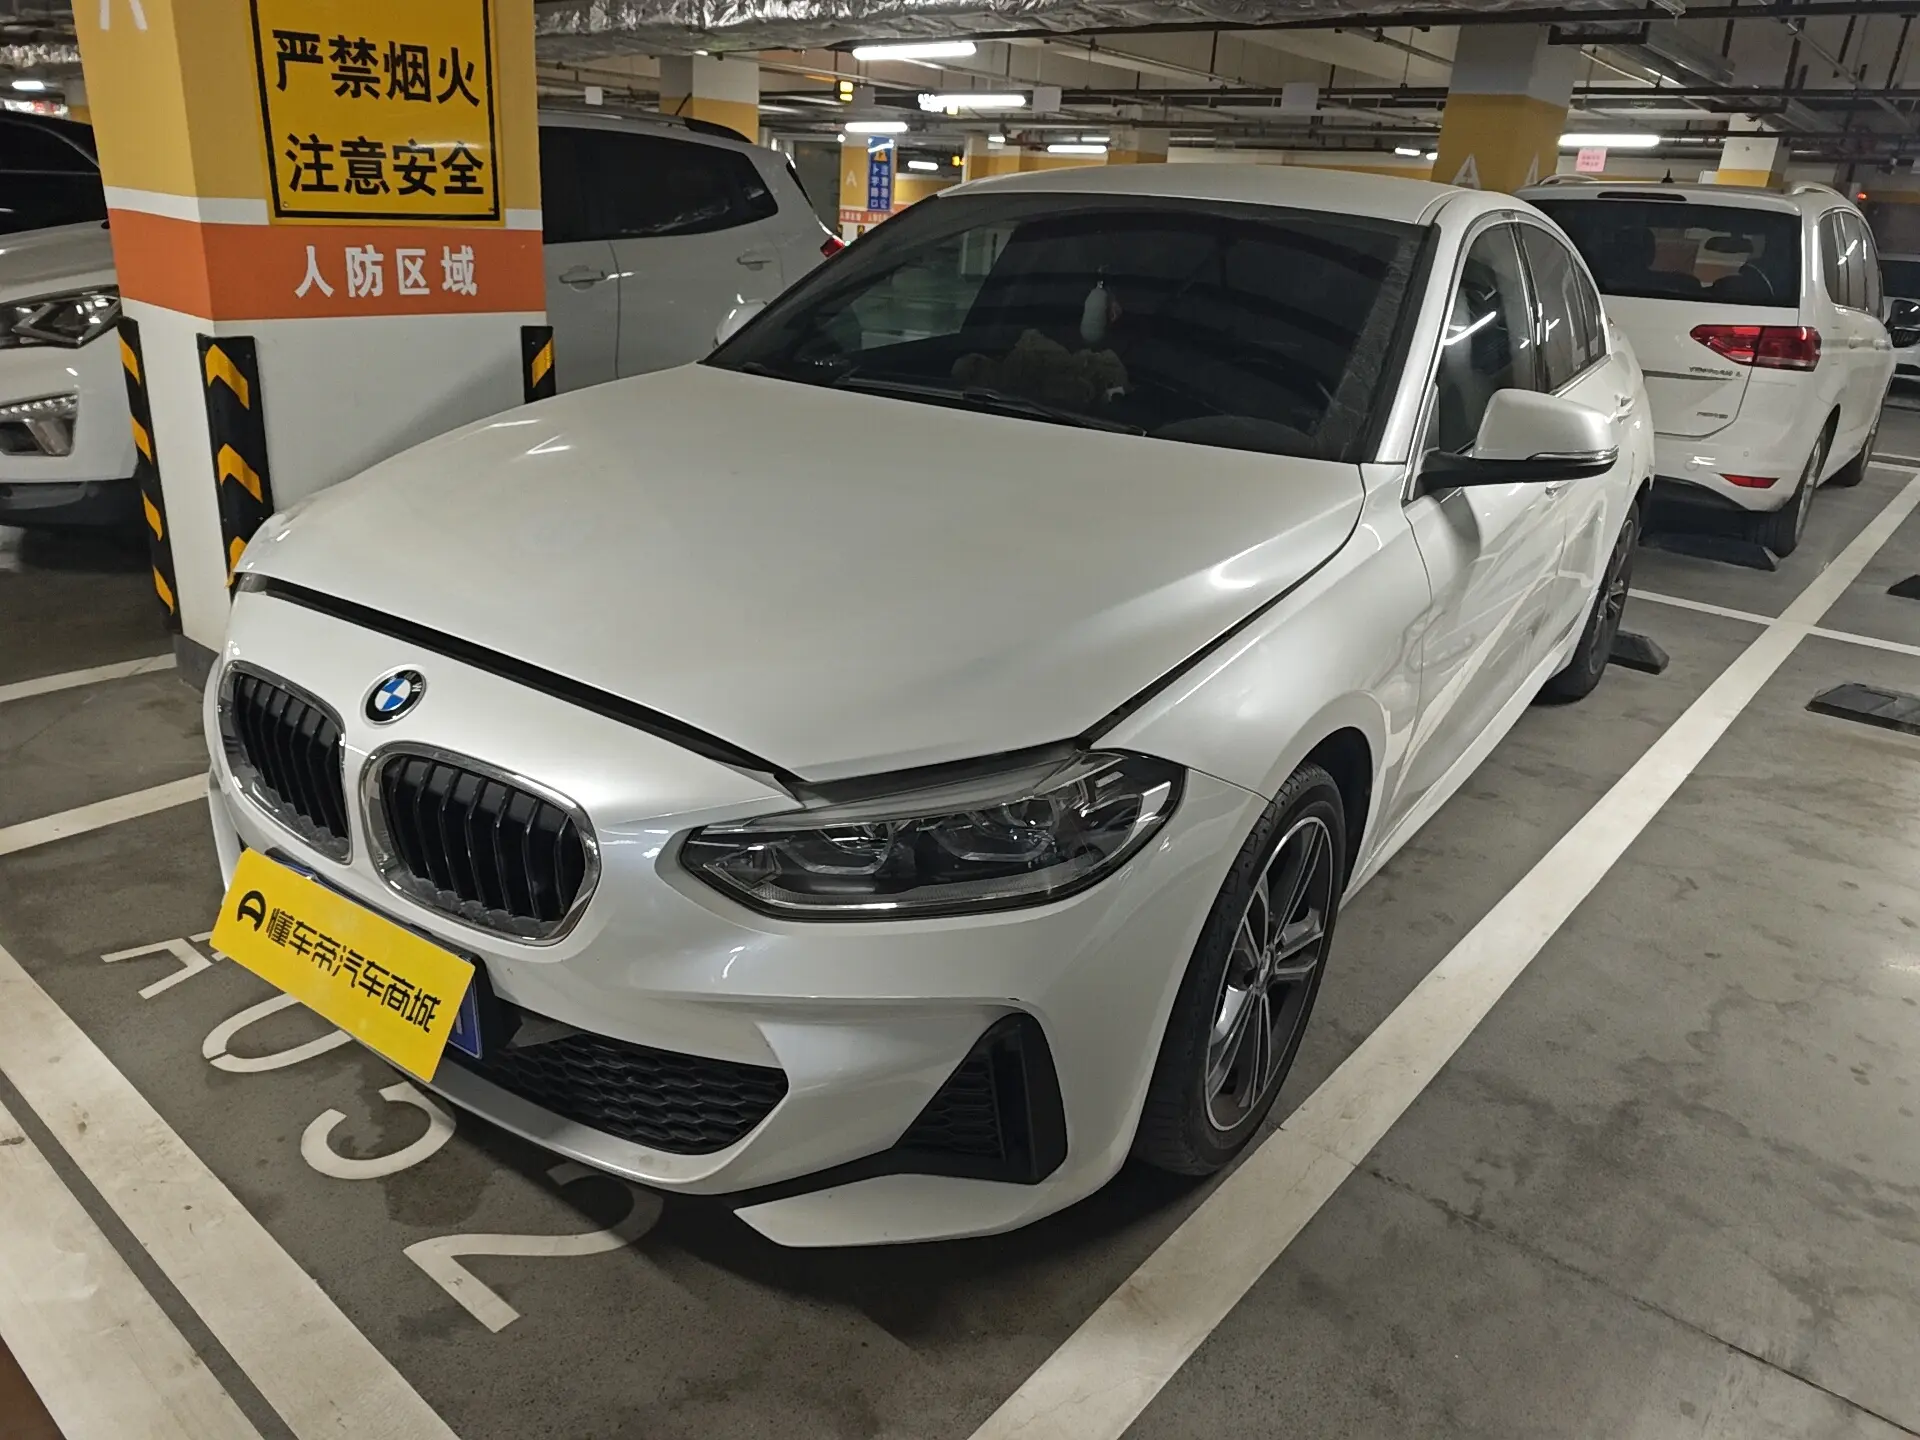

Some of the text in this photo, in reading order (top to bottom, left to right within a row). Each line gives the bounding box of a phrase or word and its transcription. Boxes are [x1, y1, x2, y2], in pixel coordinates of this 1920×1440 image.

[272, 29, 481, 107] 严禁烟火
[285, 133, 485, 196] 注意安全
[845, 170, 857, 188] A
[1451, 153, 1482, 191] A
[294, 245, 479, 298] 人防区域
[265, 906, 442, 1034] 懂车帝汽车商城
